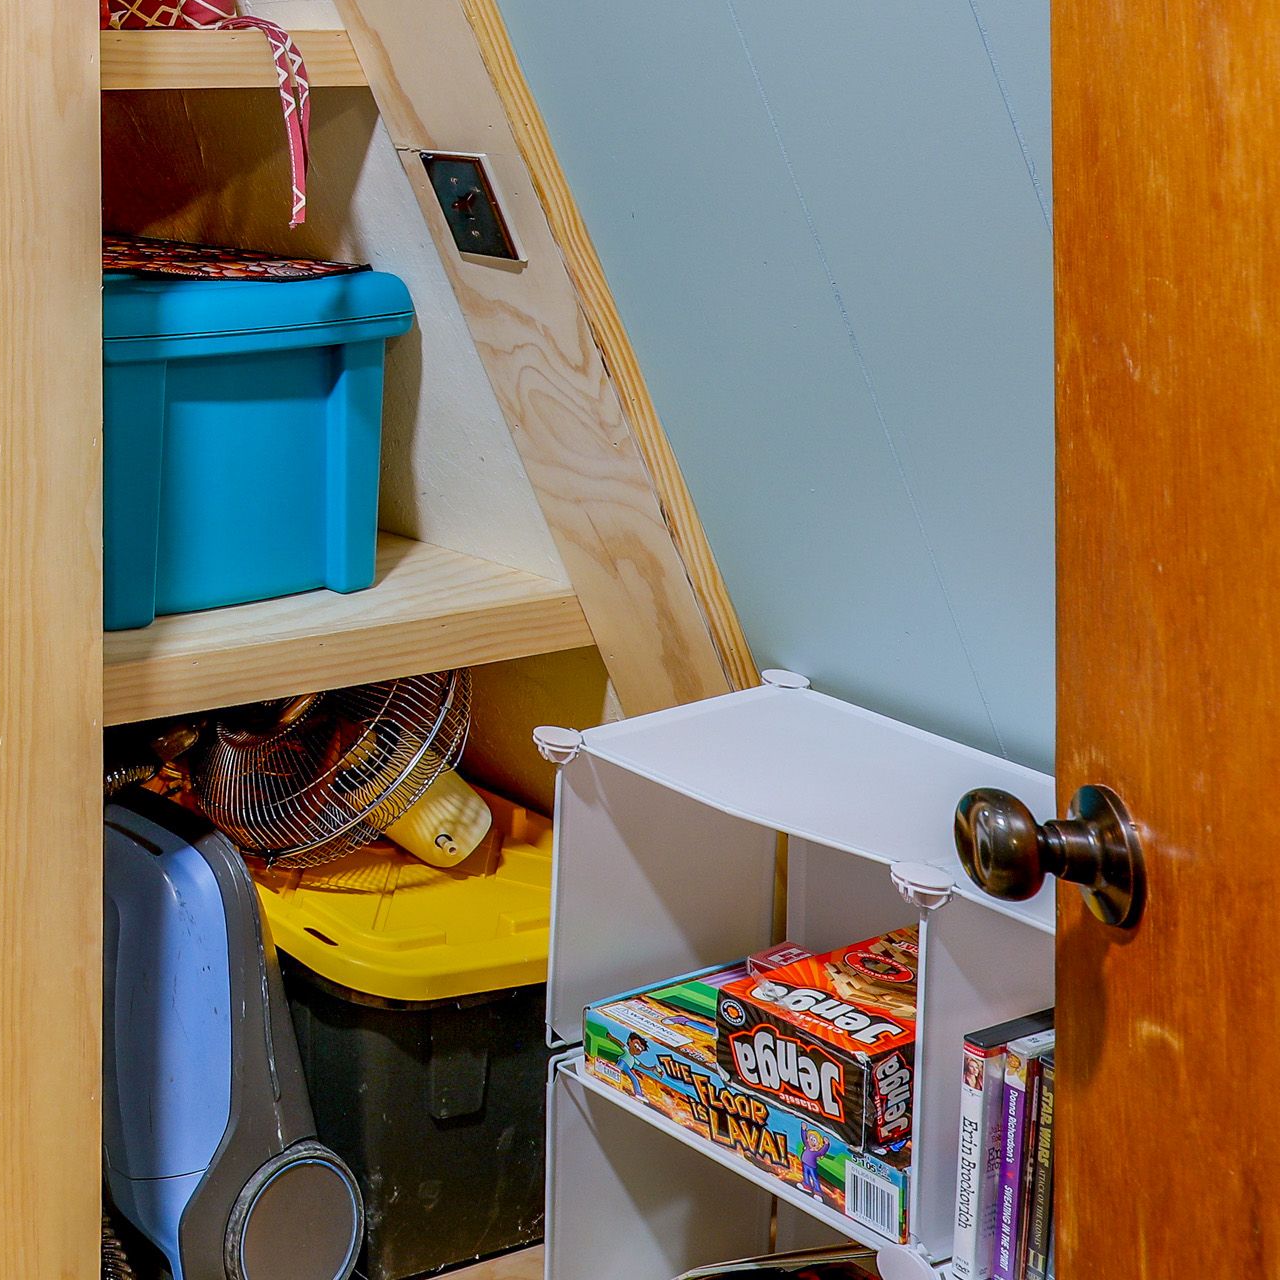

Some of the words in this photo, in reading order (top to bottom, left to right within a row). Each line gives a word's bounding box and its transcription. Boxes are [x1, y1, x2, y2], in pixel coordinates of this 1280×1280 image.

[657, 1055, 693, 1084] THE
[733, 1030, 841, 1117] Jenga
[691, 1072, 769, 1125] FLOOR
[779, 1092, 820, 1114] Classic
[874, 1054, 911, 1138] Jenga
[1009, 1089, 1019, 1115] Donna
[1040, 1085, 1054, 1126] STAR
[708, 1107, 789, 1168] LAVA!
[961, 1116, 978, 1156] Erin
[1006, 1115, 1017, 1164] Richardson's
[1038, 1125, 1052, 1168] WARS
[957, 1157, 977, 1229] Brockovich
[1002, 1184, 1013, 1225] SWEATING
[1000, 1234, 1010, 1249] THE
[1001, 1223, 1011, 1236] IN
[999, 1246, 1010, 1272] SPIRIT
